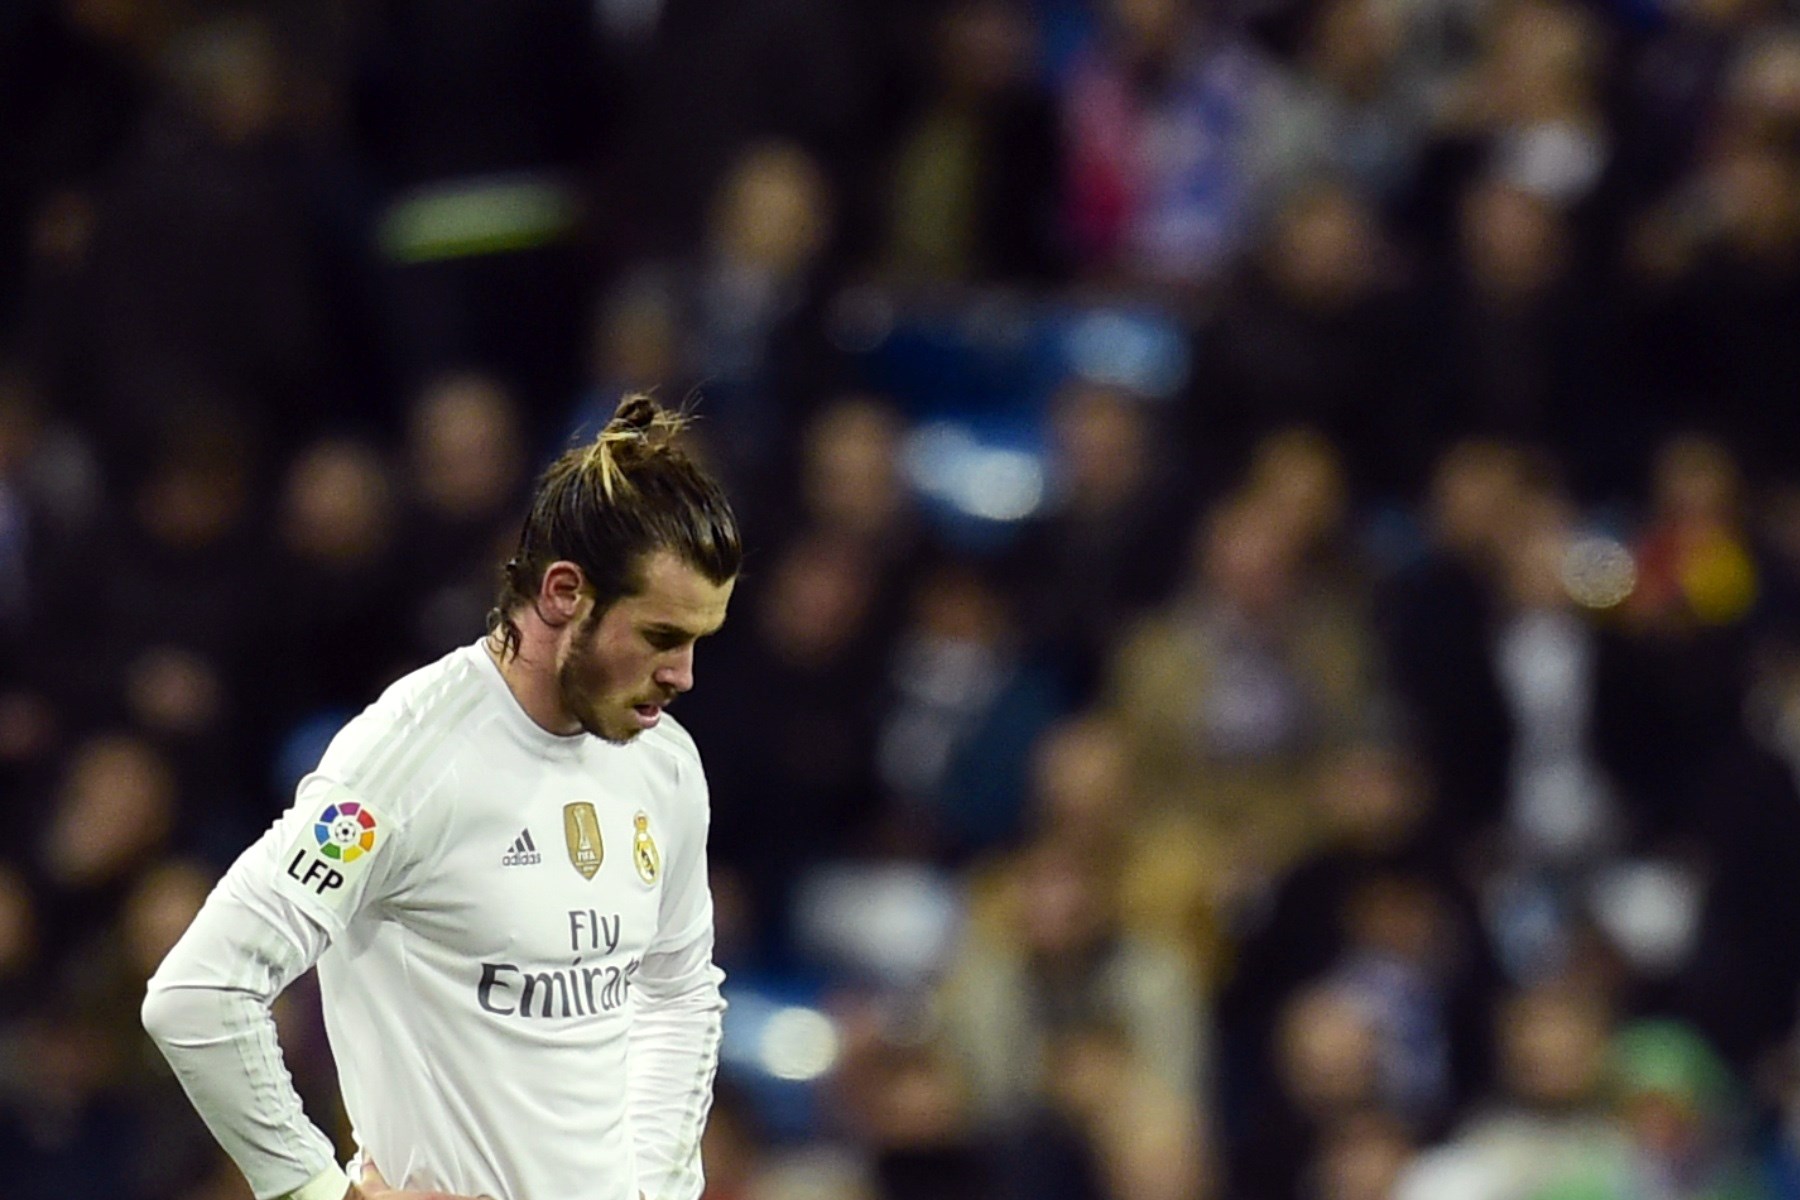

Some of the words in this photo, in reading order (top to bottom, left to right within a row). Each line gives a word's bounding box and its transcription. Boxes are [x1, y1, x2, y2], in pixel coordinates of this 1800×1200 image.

[287, 849, 344, 895] LFP
[502, 851, 542, 866] adidas
[569, 909, 620, 955] Fly
